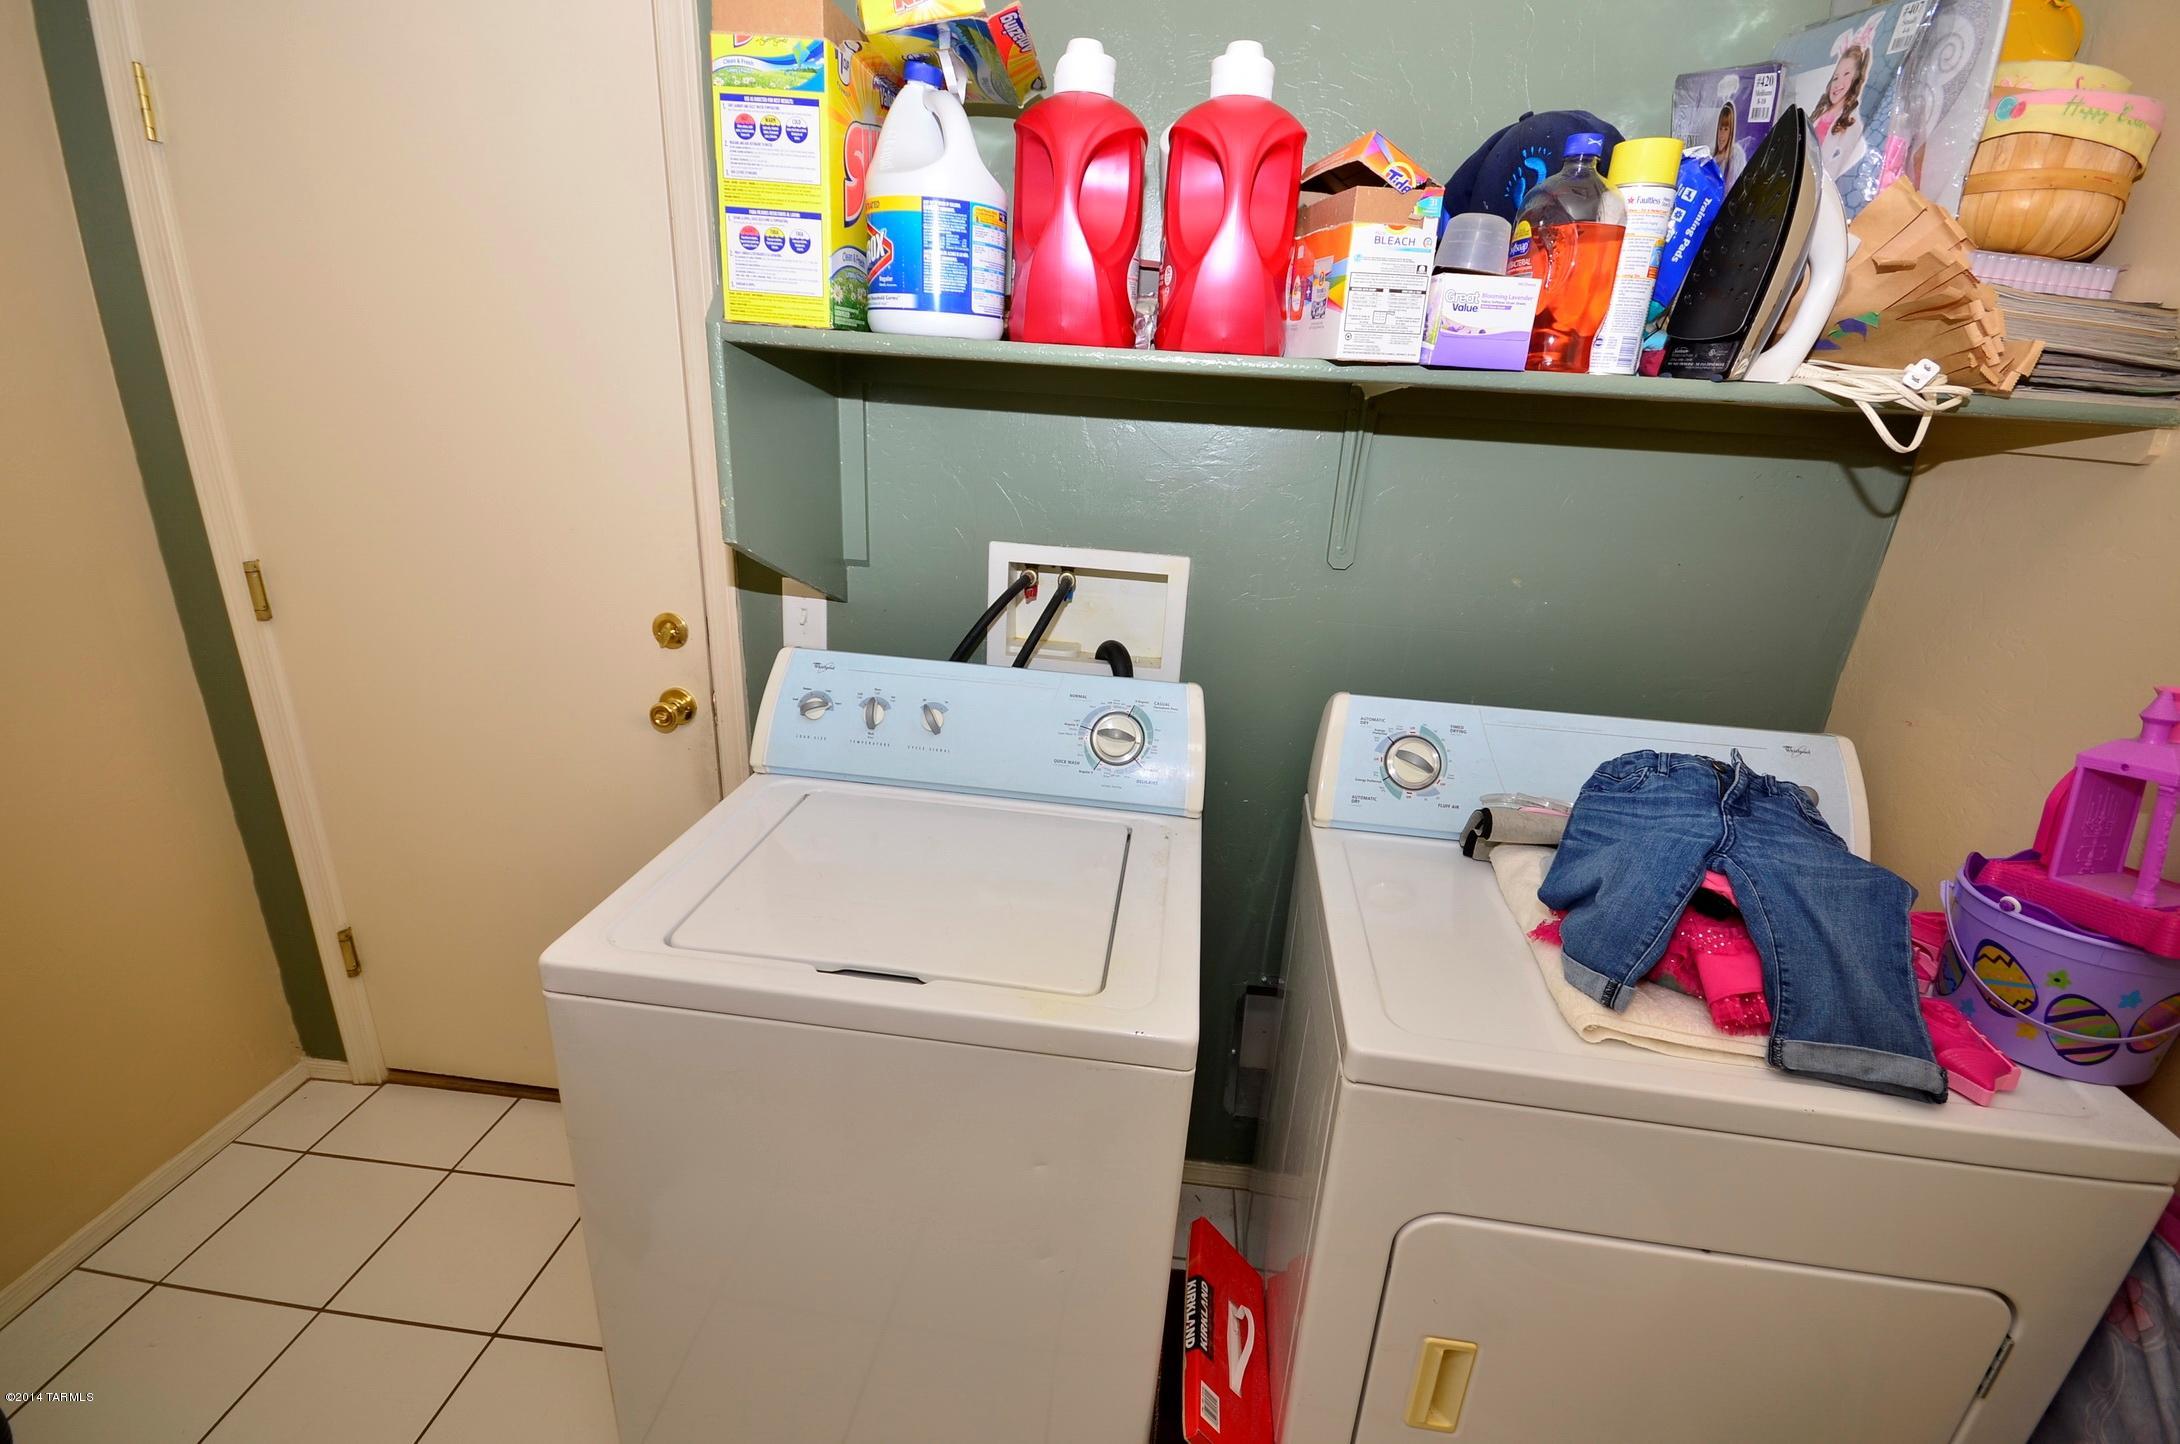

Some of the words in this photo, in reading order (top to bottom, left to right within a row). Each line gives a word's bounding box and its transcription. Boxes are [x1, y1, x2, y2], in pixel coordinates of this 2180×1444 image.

[1756, 75, 1775, 87] #420
[2062, 94, 2109, 124] Happy
[1388, 168, 1413, 193] Tide
[1636, 195, 1660, 205] Faultless
[1685, 197, 1713, 238] Training
[1374, 235, 1416, 247] BLEACH
[1671, 238, 1691, 263] Pads
[1444, 288, 1481, 304] Great
[1481, 293, 1508, 301] Blooming
[1508, 293, 1534, 301] Lavender
[1452, 303, 1479, 312] Value
[1782, 745, 1811, 755] Whirlpool
[1352, 794, 1377, 802] AUTOMATIC
[1186, 1279, 1197, 1349] KIRKLAND
[1200, 1280, 1209, 1352] KIRKLAND
